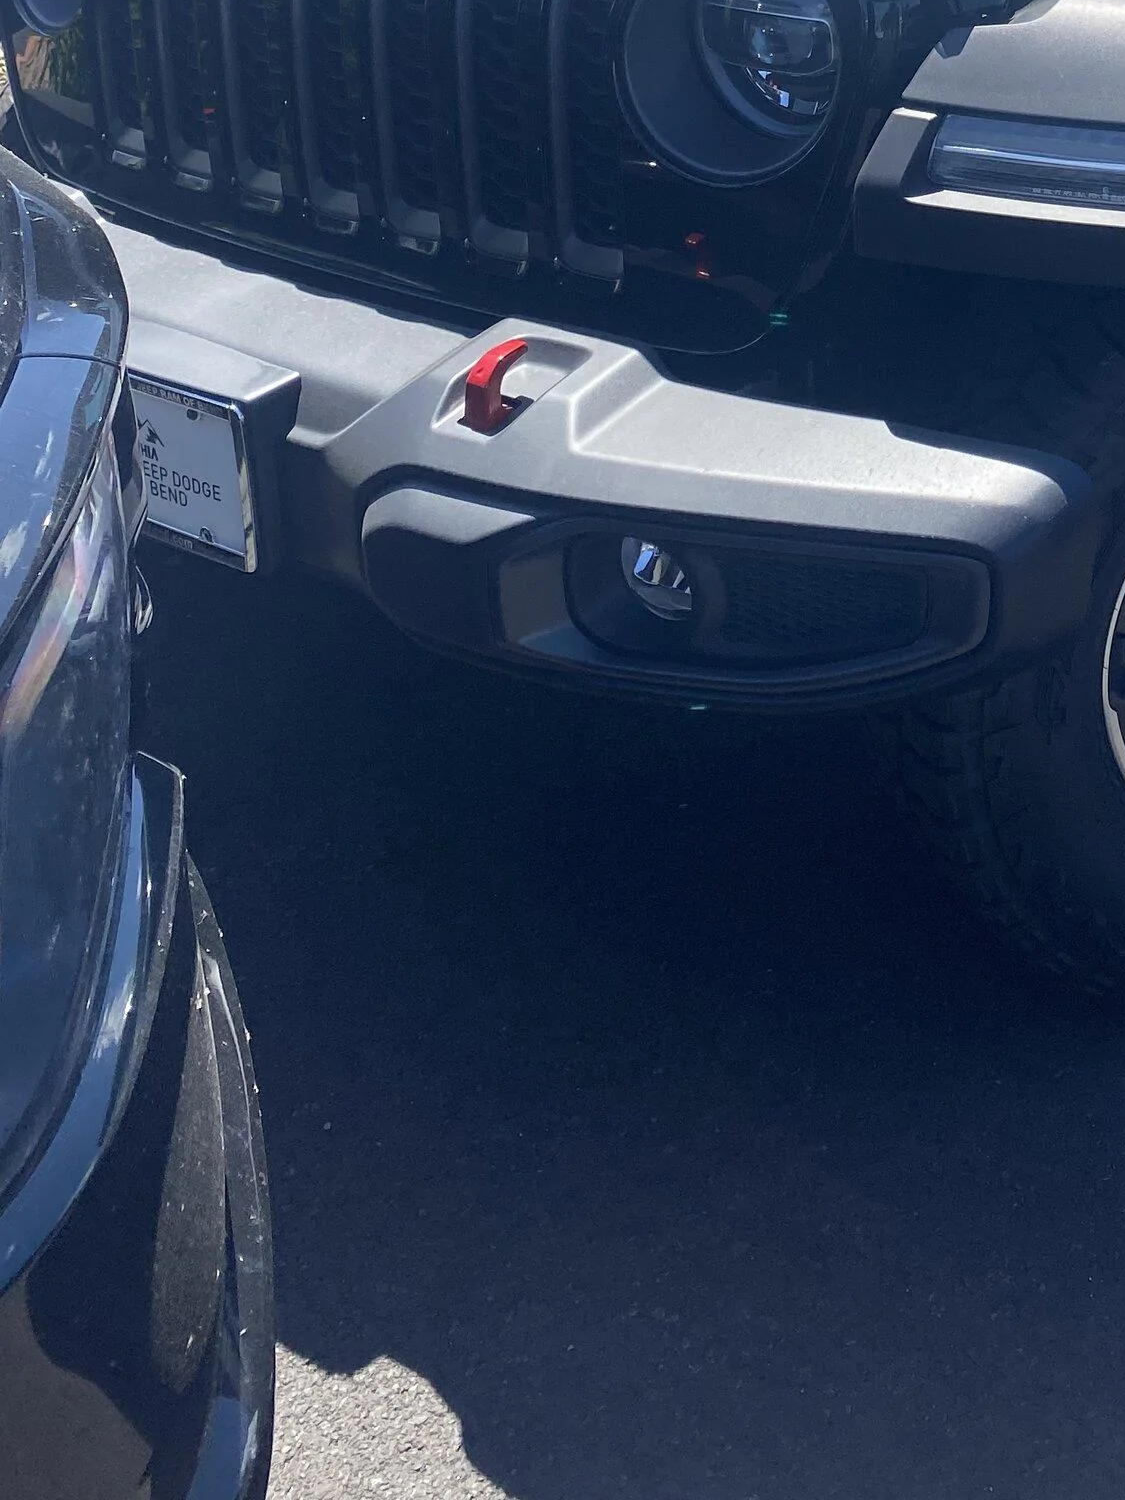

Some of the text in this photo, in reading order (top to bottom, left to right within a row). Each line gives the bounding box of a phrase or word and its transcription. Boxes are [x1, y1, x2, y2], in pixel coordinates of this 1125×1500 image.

[159, 389, 183, 405] RAM
[150, 480, 189, 507] BEND
[171, 471, 222, 502] DODGE
